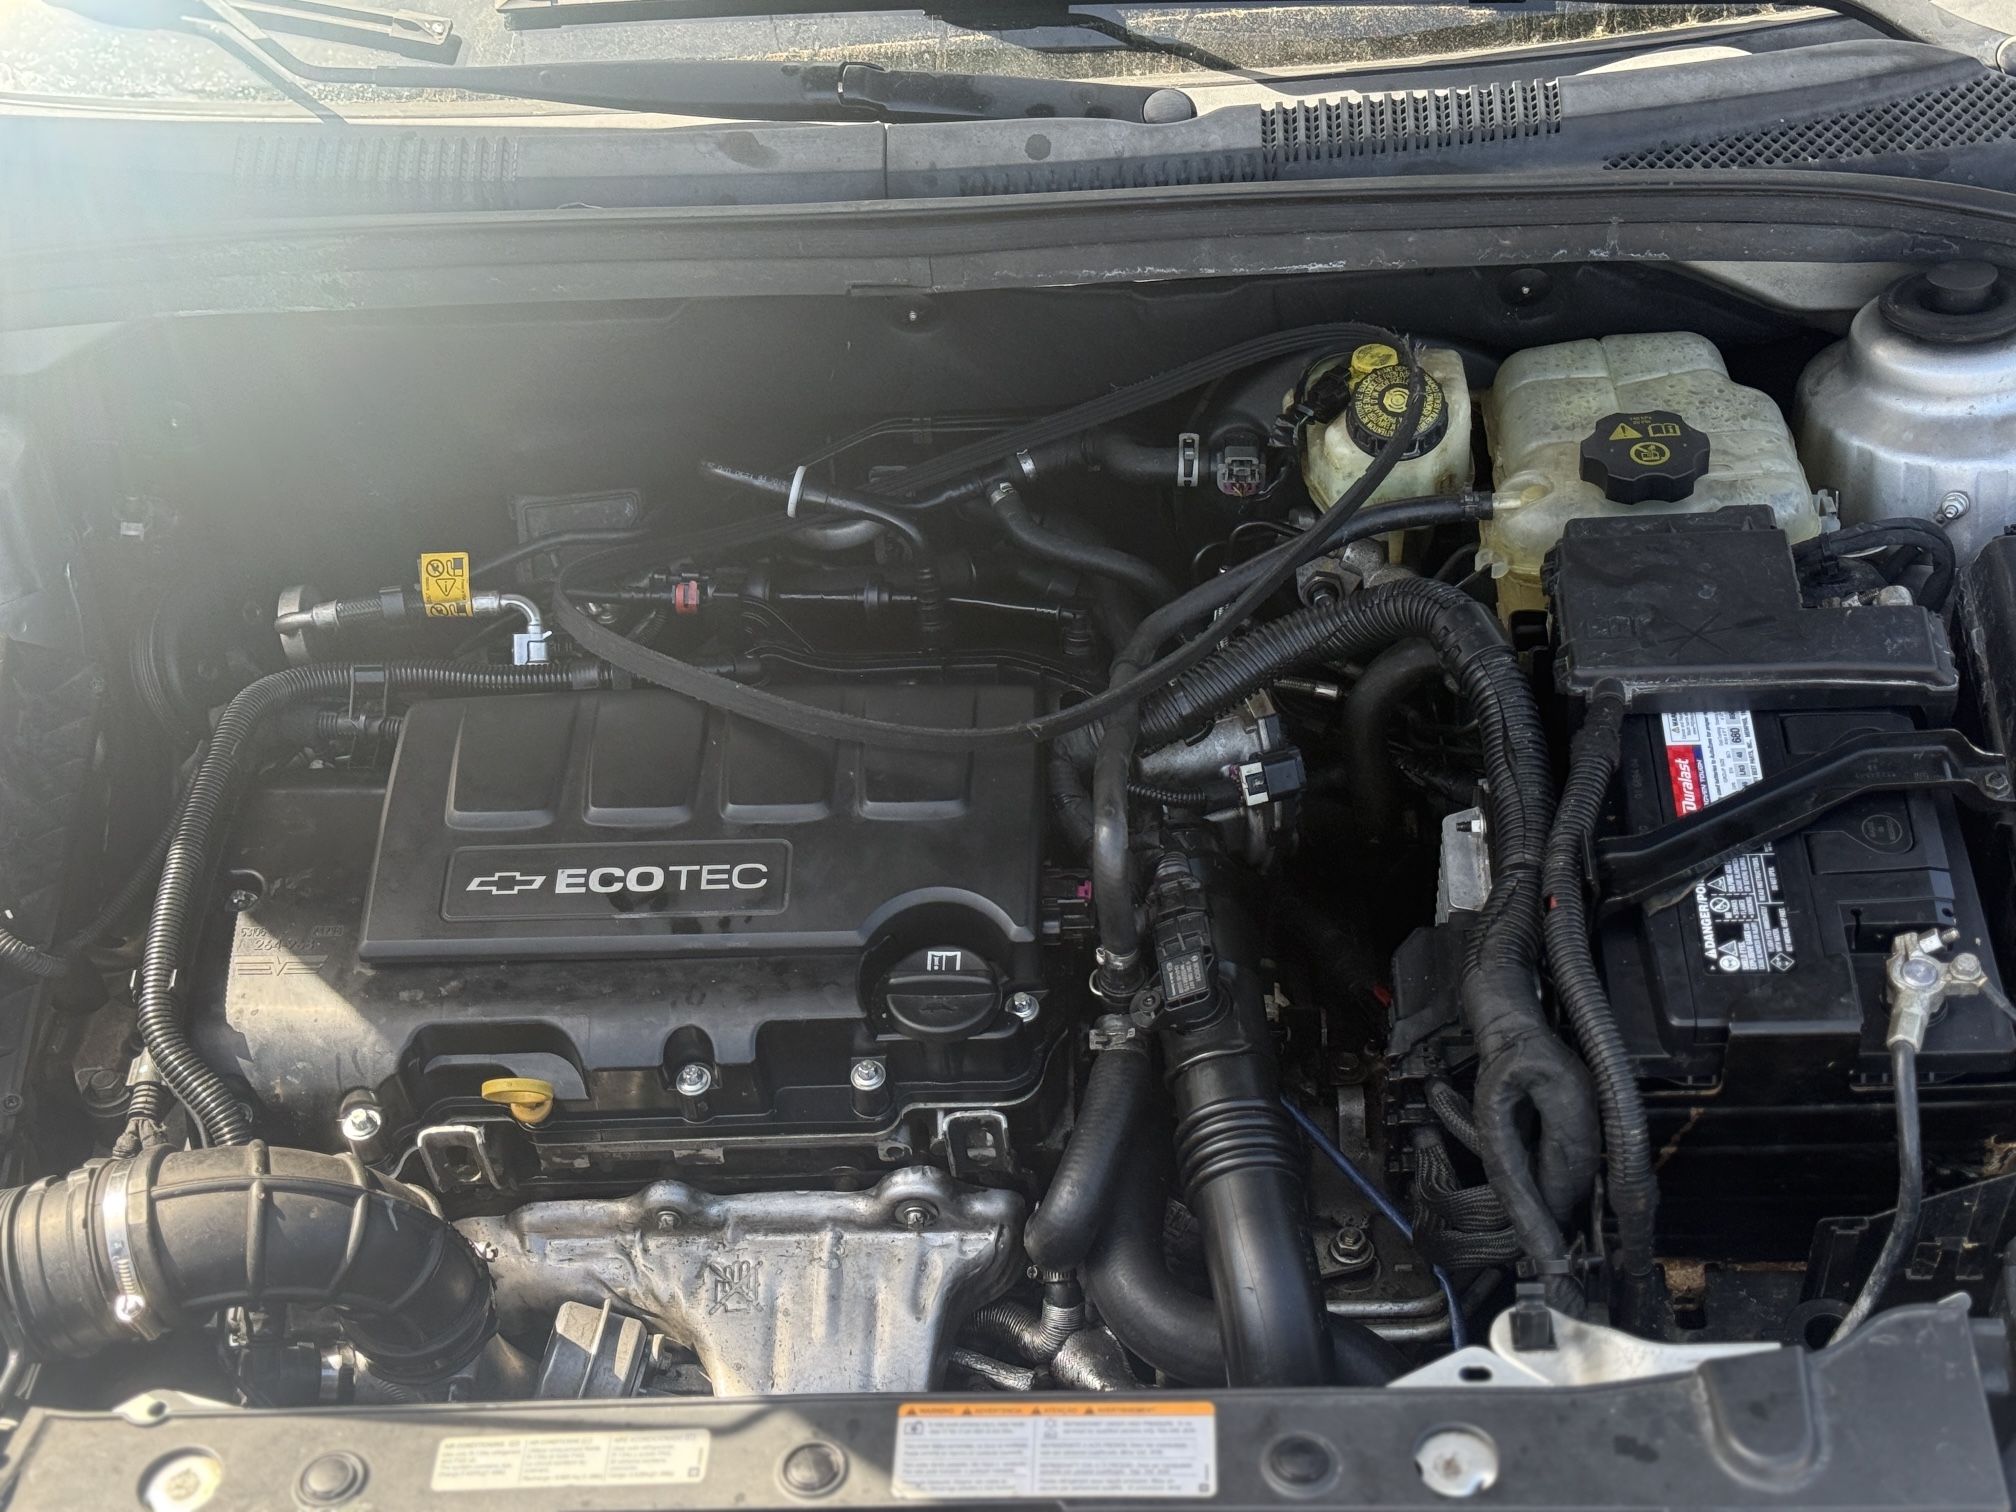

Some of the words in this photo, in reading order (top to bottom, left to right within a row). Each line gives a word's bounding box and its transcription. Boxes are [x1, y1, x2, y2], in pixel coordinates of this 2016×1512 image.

[1730, 727, 1741, 743] 680
[1675, 758, 1697, 813] Duralast
[554, 863, 768, 894] ECOTEC
[1695, 879, 1714, 949] DANGER/POI
